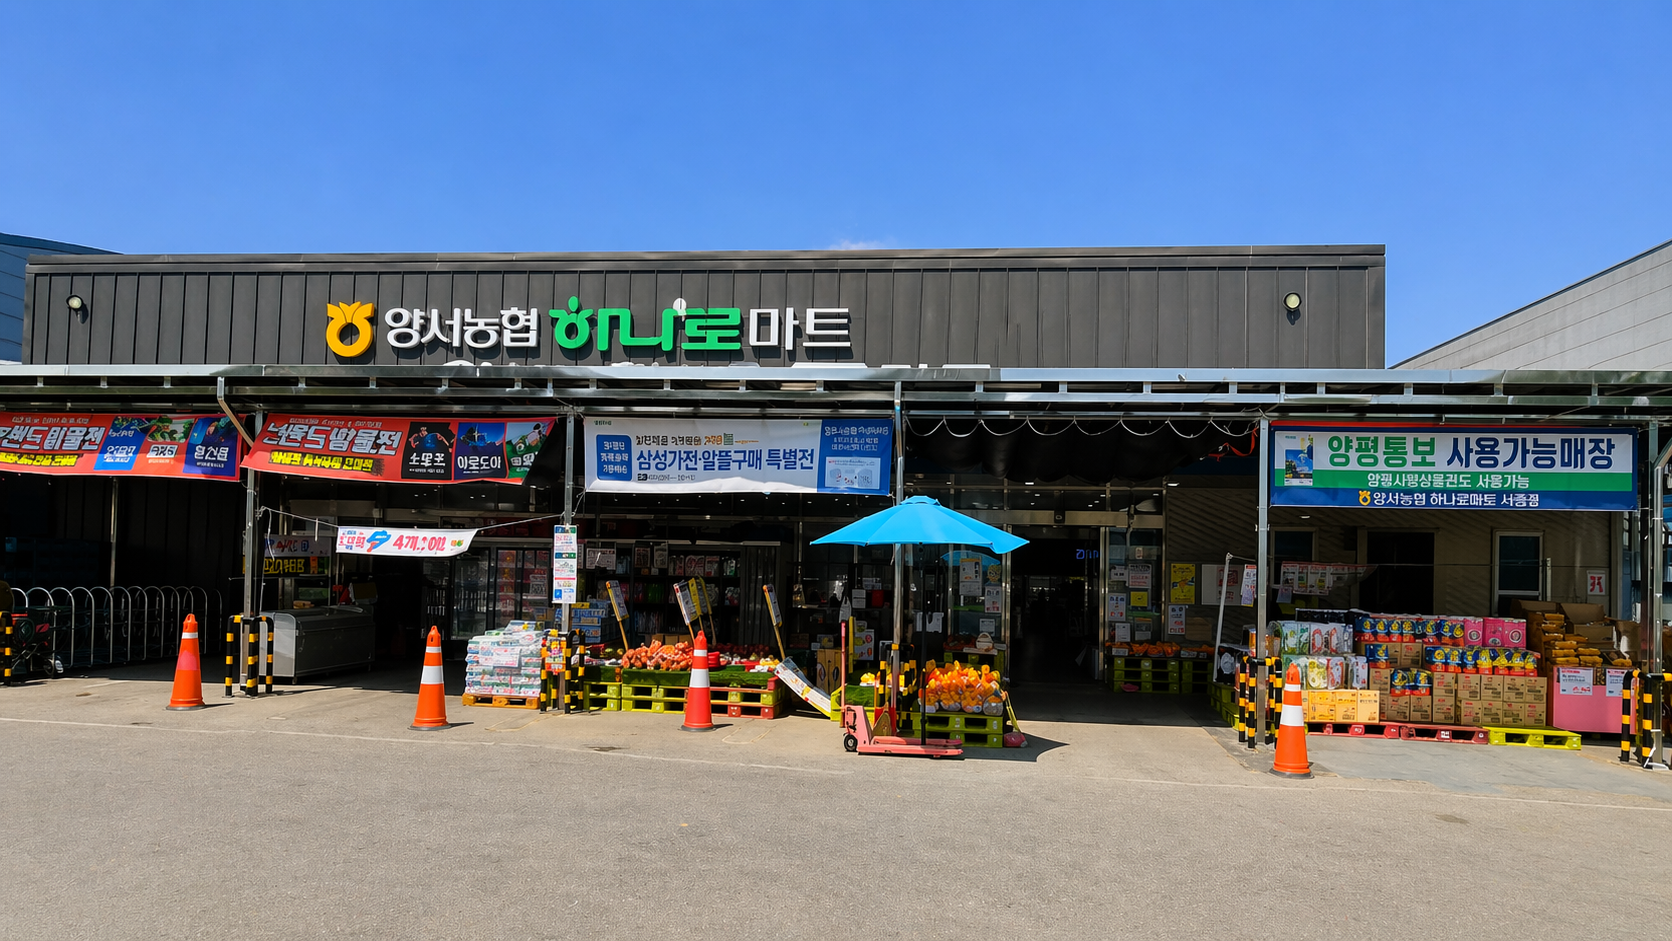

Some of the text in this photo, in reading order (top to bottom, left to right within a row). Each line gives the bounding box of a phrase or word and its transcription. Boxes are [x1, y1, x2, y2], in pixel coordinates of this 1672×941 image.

[385, 296, 851, 351] 양서농협 하나로마트
[766, 448, 815, 472] 특별전
[1328, 435, 1616, 470] 양평통보 사용가능매장
